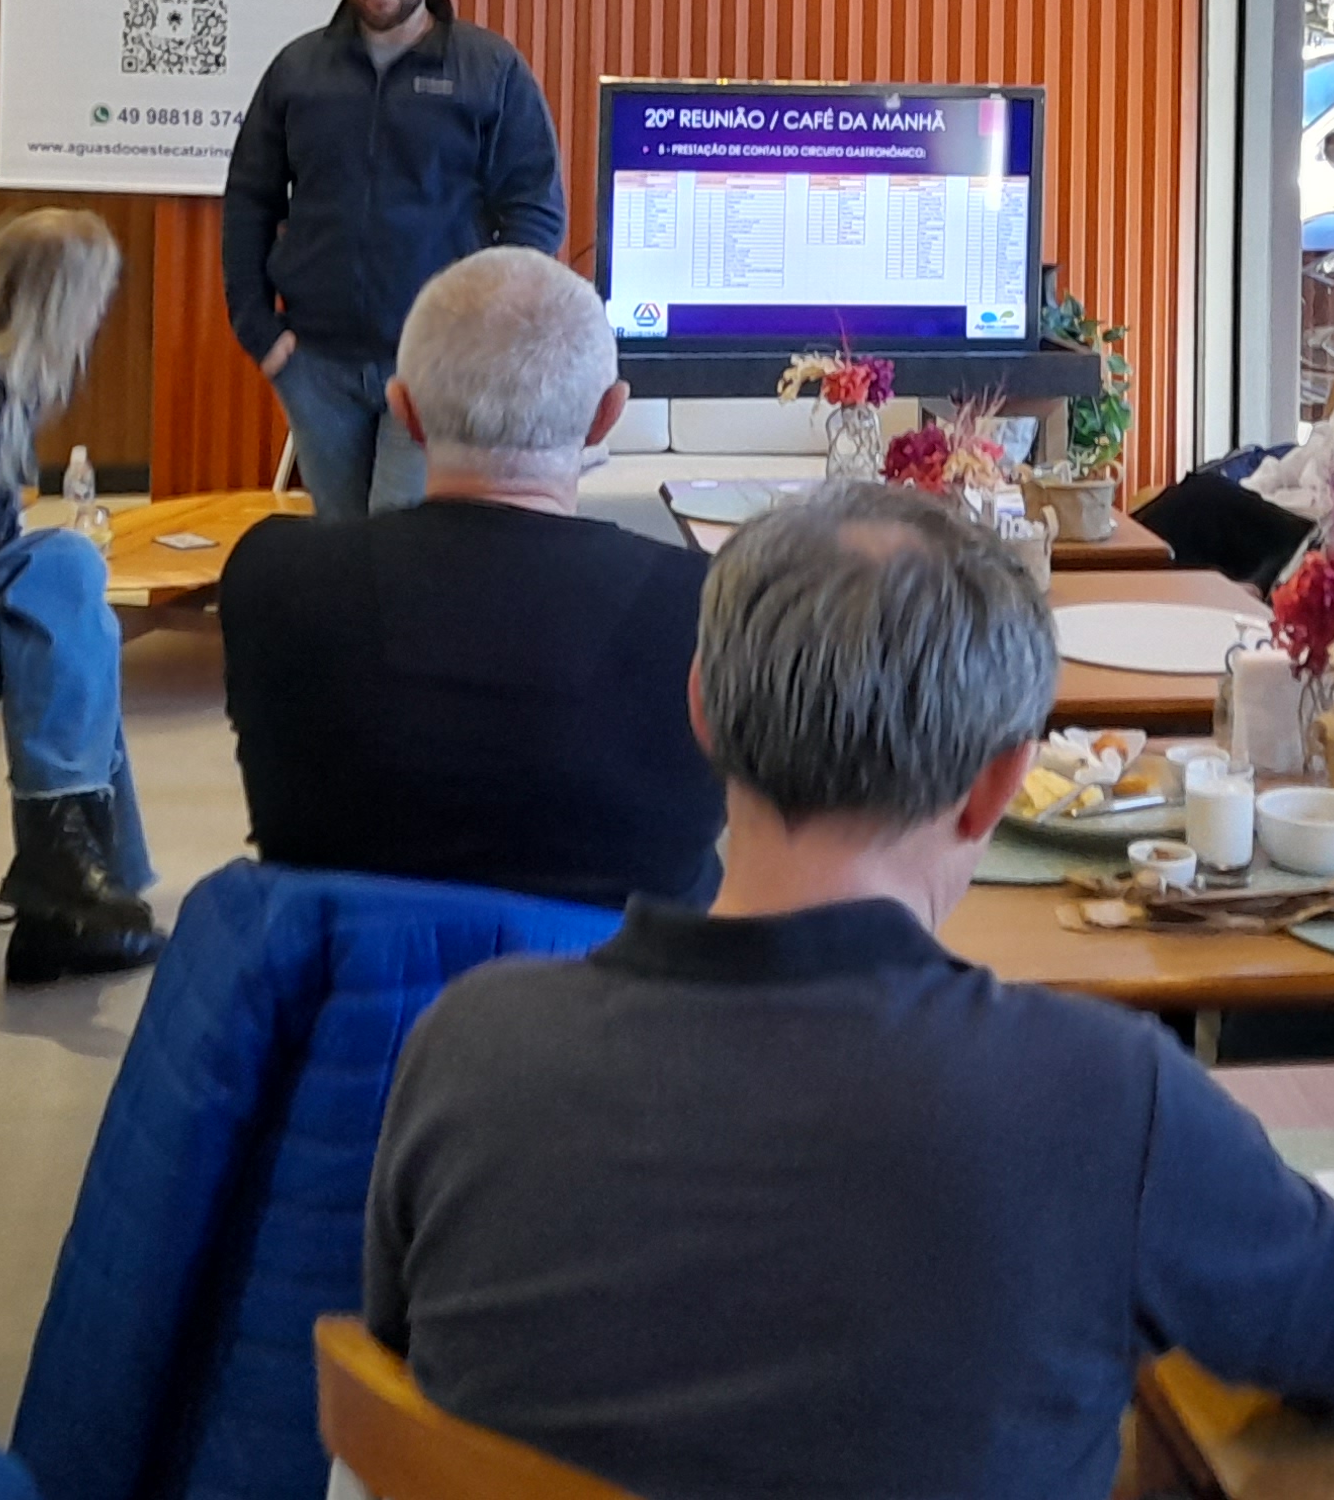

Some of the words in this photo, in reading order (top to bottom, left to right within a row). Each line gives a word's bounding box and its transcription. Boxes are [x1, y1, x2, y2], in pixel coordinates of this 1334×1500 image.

[117, 108, 140, 125] 49
[146, 108, 204, 126] 98818
[209, 109, 246, 127] 374
[679, 105, 766, 130] REUNIÃO
[769, 109, 780, 131] /
[783, 106, 835, 131] CAFÉ
[838, 111, 868, 131] DA
[872, 109, 947, 132] MANHÃ
[671, 142, 727, 157] PRESTAÇÃO
[728, 144, 742, 156] DE
[742, 144, 782, 157] CONTAS
[782, 145, 799, 157] DO
